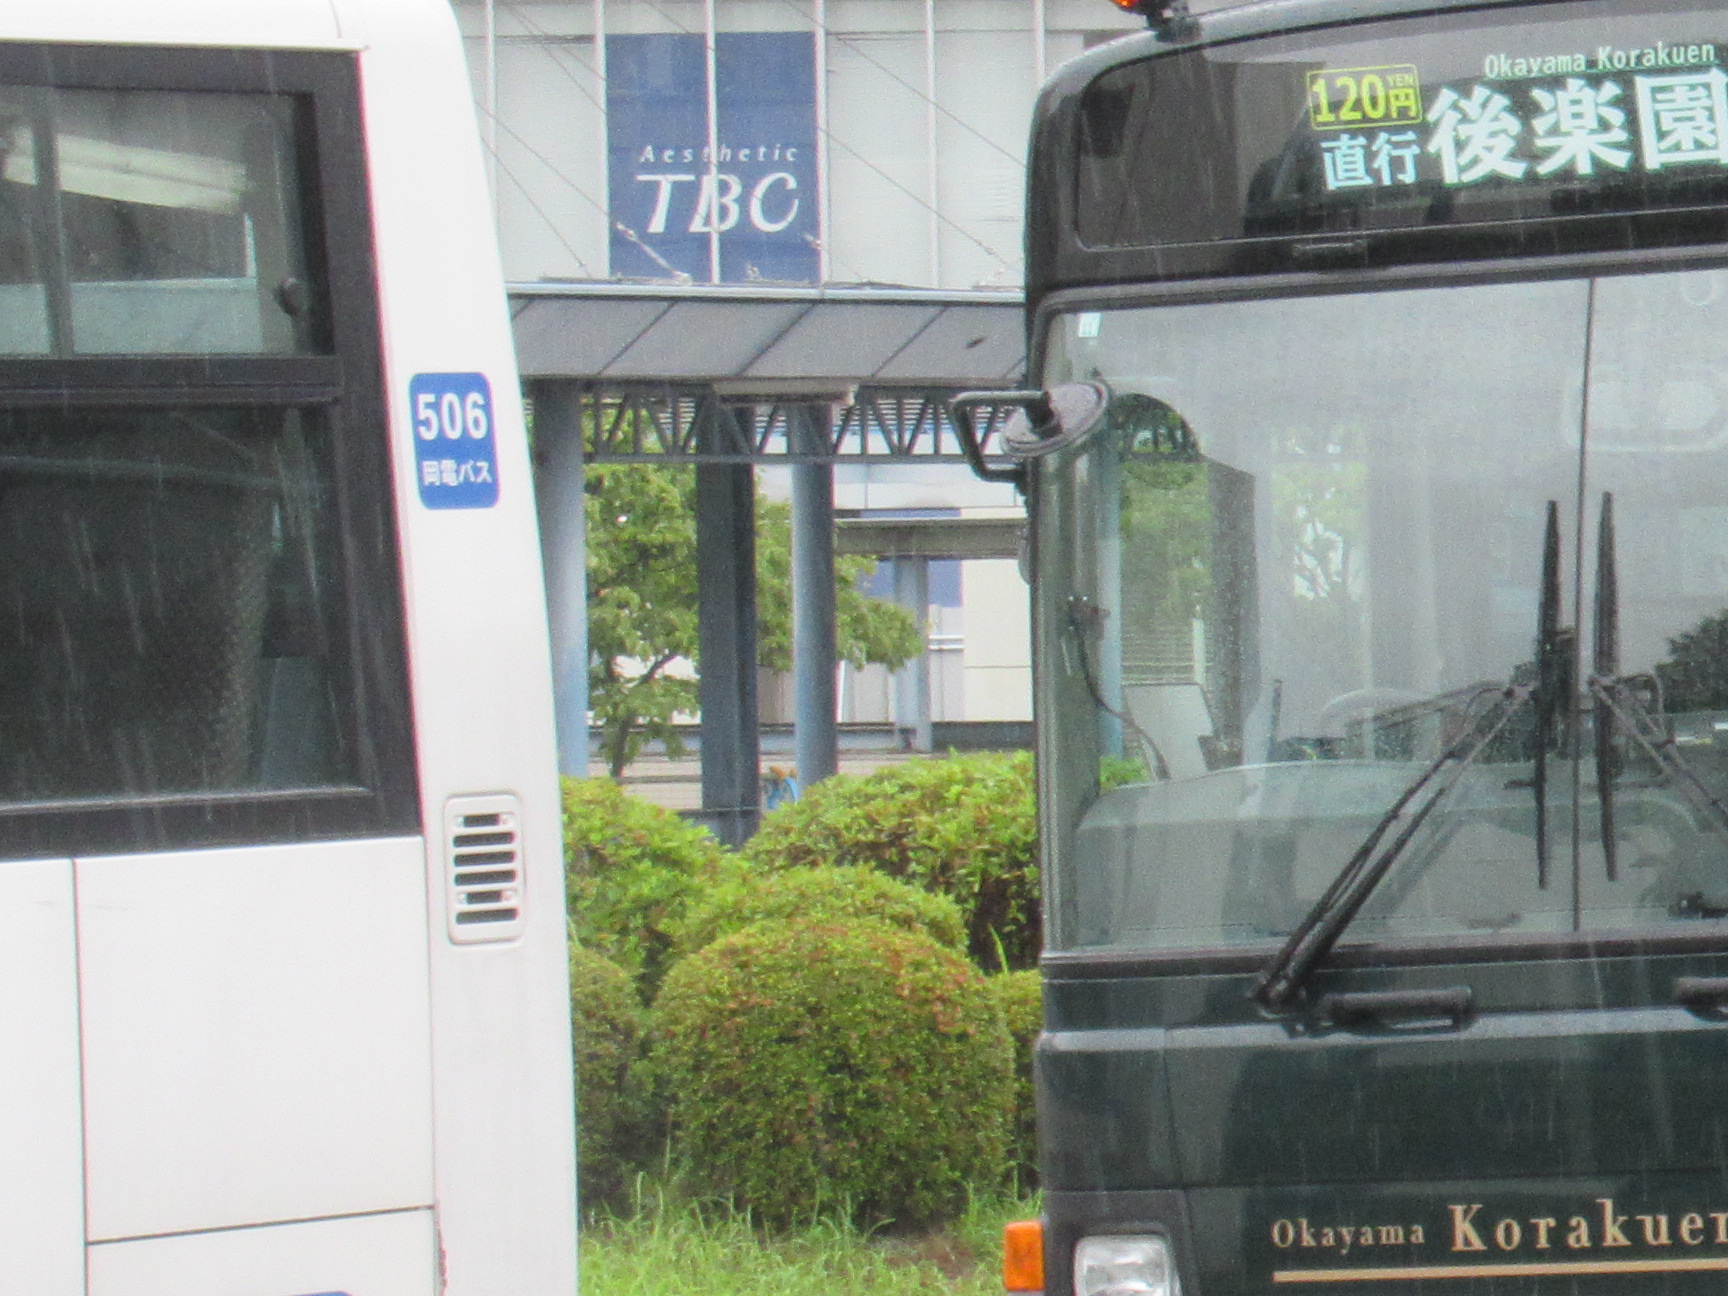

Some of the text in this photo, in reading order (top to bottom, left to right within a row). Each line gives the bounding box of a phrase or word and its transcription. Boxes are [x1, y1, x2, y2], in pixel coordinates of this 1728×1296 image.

[1484, 41, 1716, 79] Okayama Korakuen
[1312, 74, 1418, 122] 120円
[639, 143, 798, 164] Aesthetic
[1320, 131, 1421, 190] 直行
[634, 172, 799, 233] TBC
[417, 392, 488, 441] 506
[1270, 1217, 1425, 1254] Okayama
